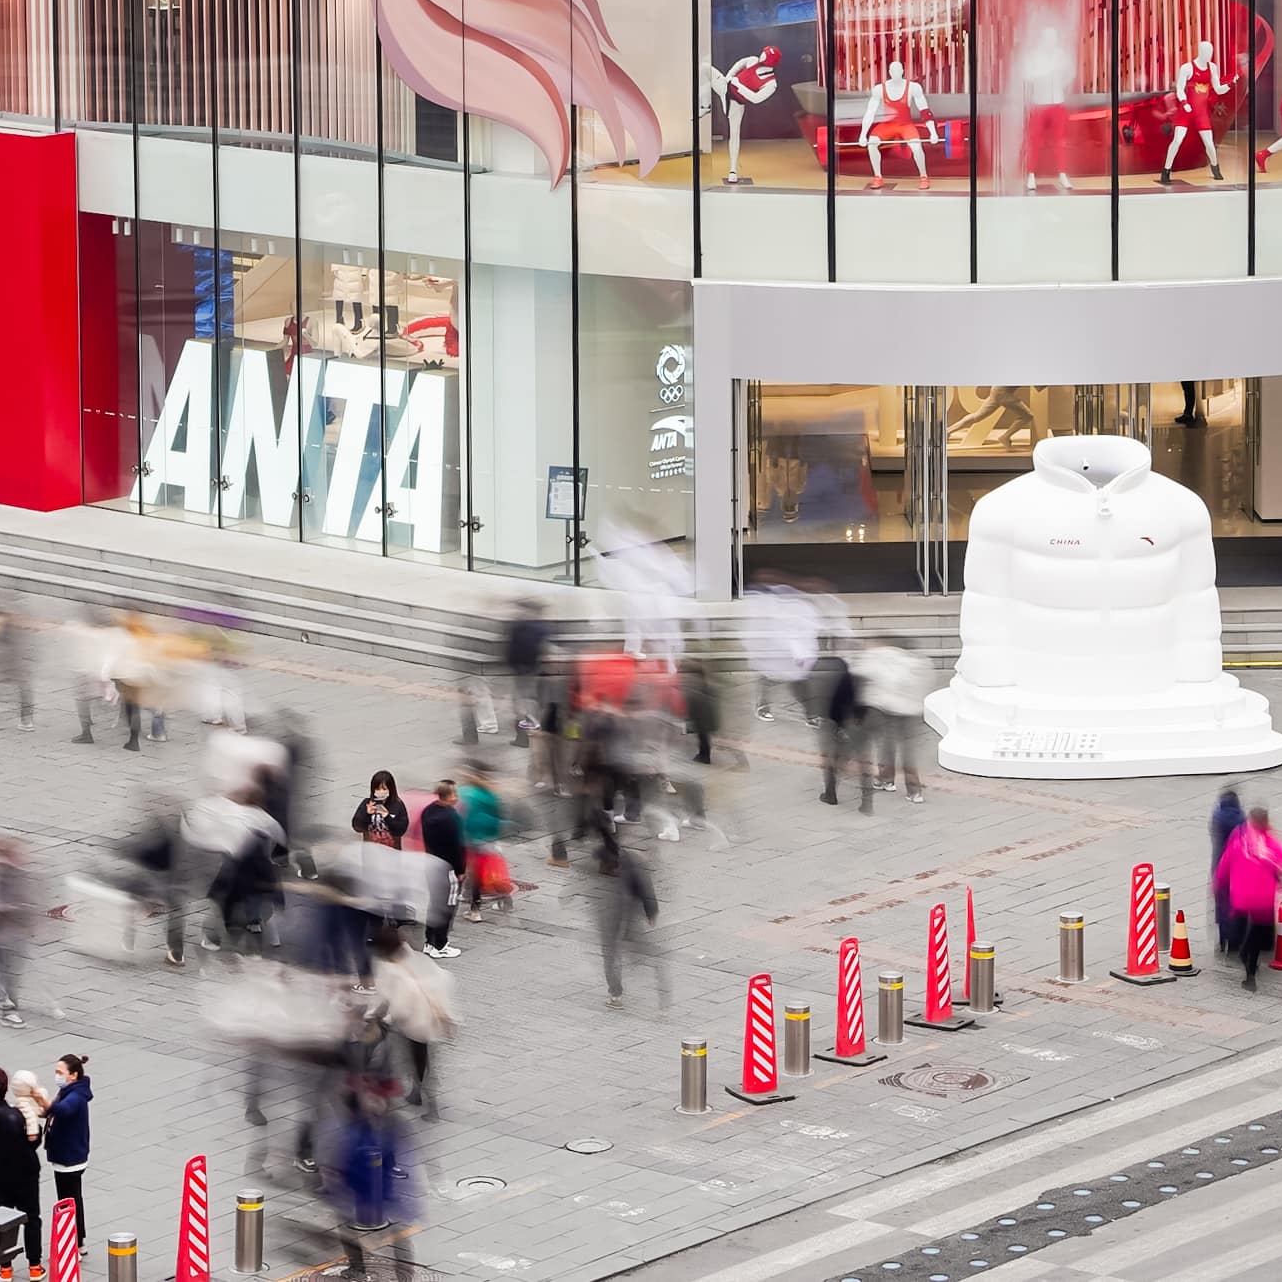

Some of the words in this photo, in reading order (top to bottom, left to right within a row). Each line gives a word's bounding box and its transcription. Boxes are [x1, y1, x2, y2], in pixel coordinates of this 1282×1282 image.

[128, 338, 450, 554] ANTA
[650, 431, 678, 452] ANTA
[1049, 538, 1081, 546] CHINA
